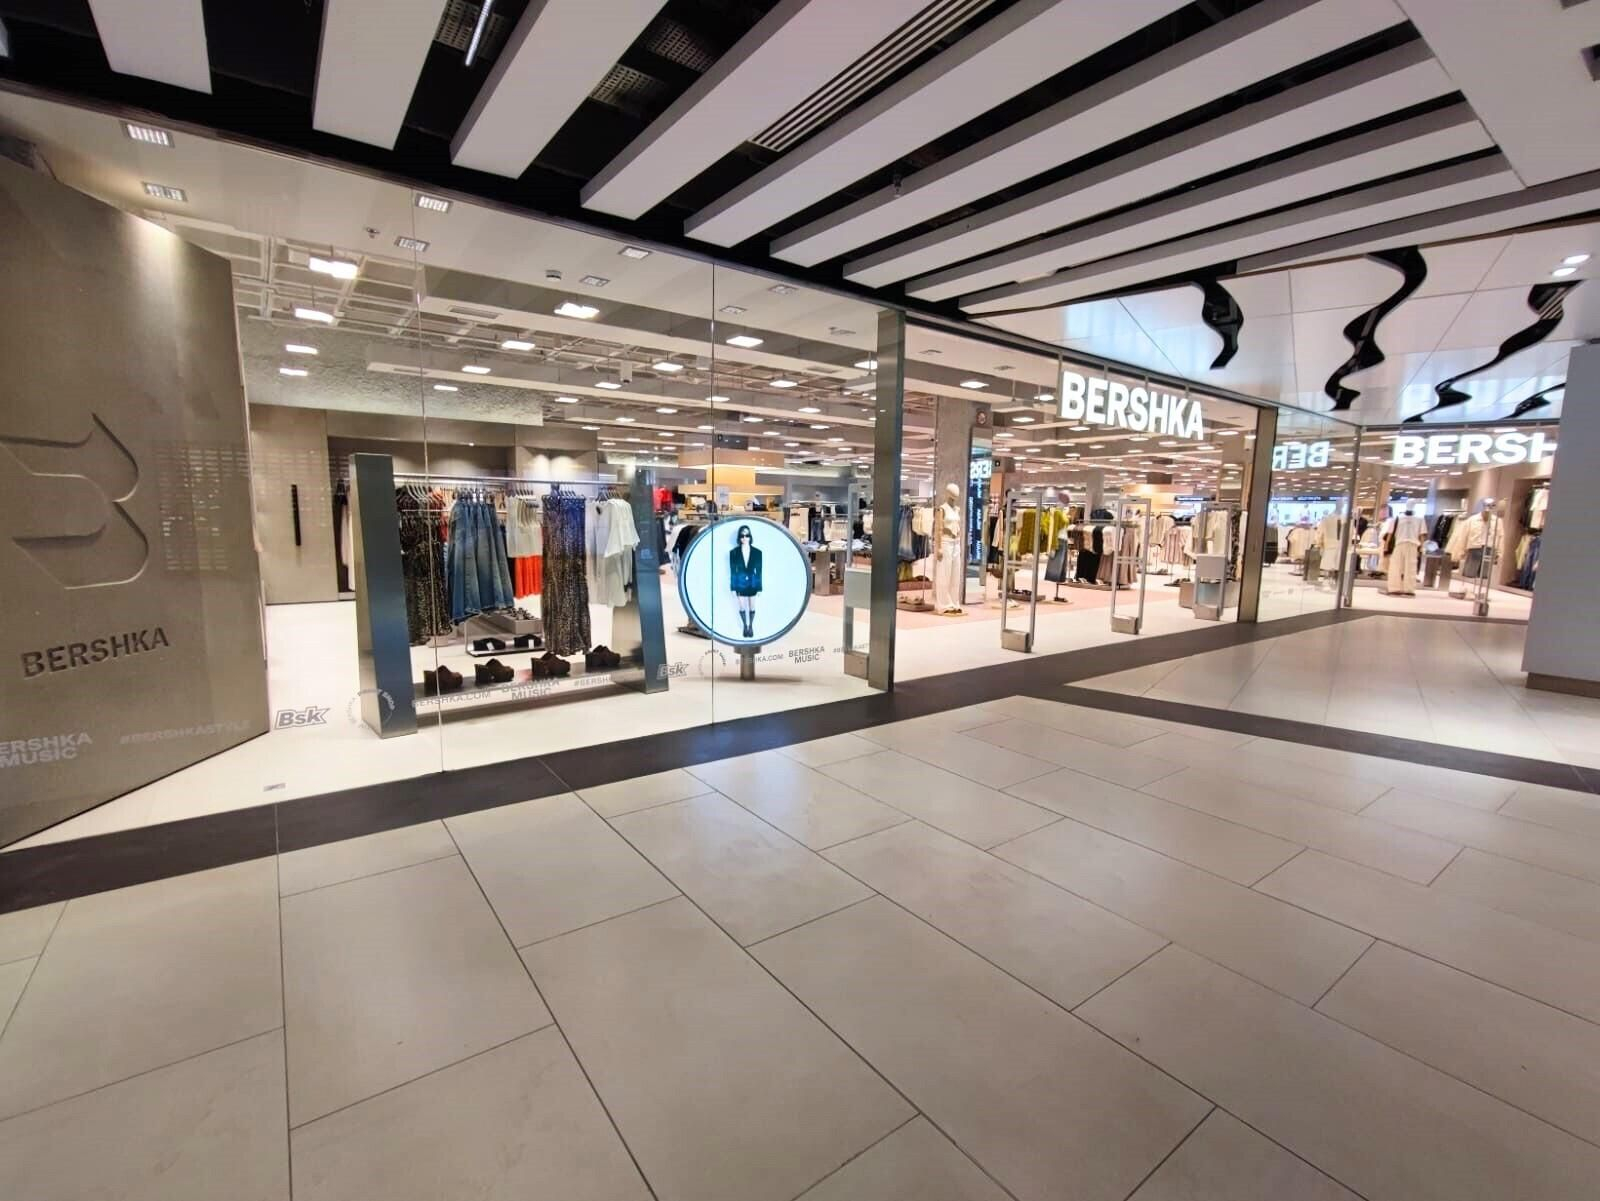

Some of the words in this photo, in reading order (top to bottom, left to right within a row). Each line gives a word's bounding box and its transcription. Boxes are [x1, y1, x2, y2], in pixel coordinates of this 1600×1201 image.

[1060, 370, 1204, 441] BERSHKA
[21, 627, 170, 680] BERSHKA
[788, 646, 825, 658] BERSHKA
[794, 653, 821, 664] MUSIC
[656, 662, 689, 680] Bsk
[511, 687, 552, 701] MUSIC
[276, 706, 329, 730] Bsk
